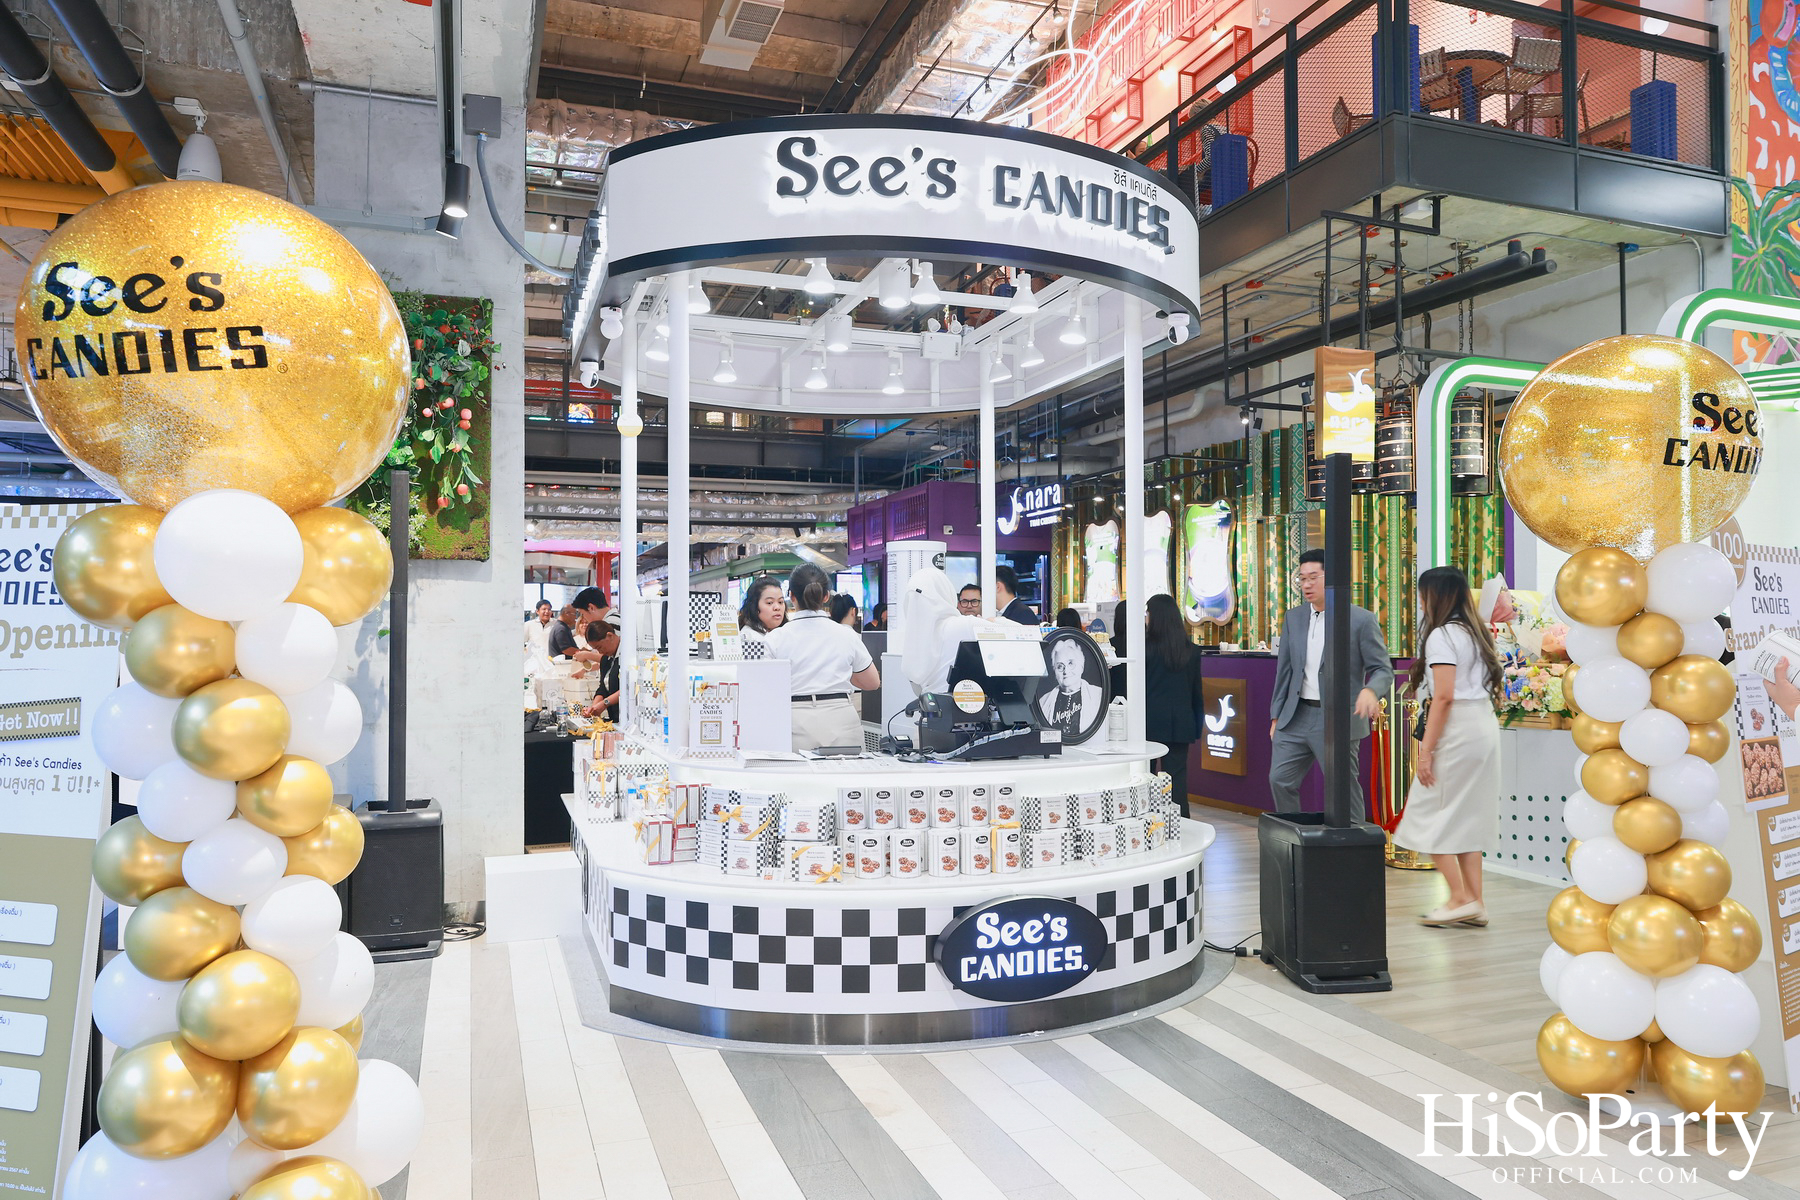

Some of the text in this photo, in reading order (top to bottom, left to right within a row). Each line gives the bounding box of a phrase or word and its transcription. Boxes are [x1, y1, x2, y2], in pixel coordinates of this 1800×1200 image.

[776, 137, 1170, 247] See's CANDIES
[43, 256, 225, 322] See's
[27, 326, 269, 381] CANDIES
[1692, 392, 1758, 437] See
[1025, 483, 1061, 511] nara
[0, 543, 54, 572] ee's
[1716, 531, 1743, 560] 100
[1753, 566, 1783, 593] See's
[1751, 596, 1790, 615] CANDIES
[26, 707, 79, 729] Now!!
[15, 756, 39, 768] See's
[42, 757, 82, 770] Candies
[51, 774, 61, 792] 1
[976, 912, 1068, 949] See's
